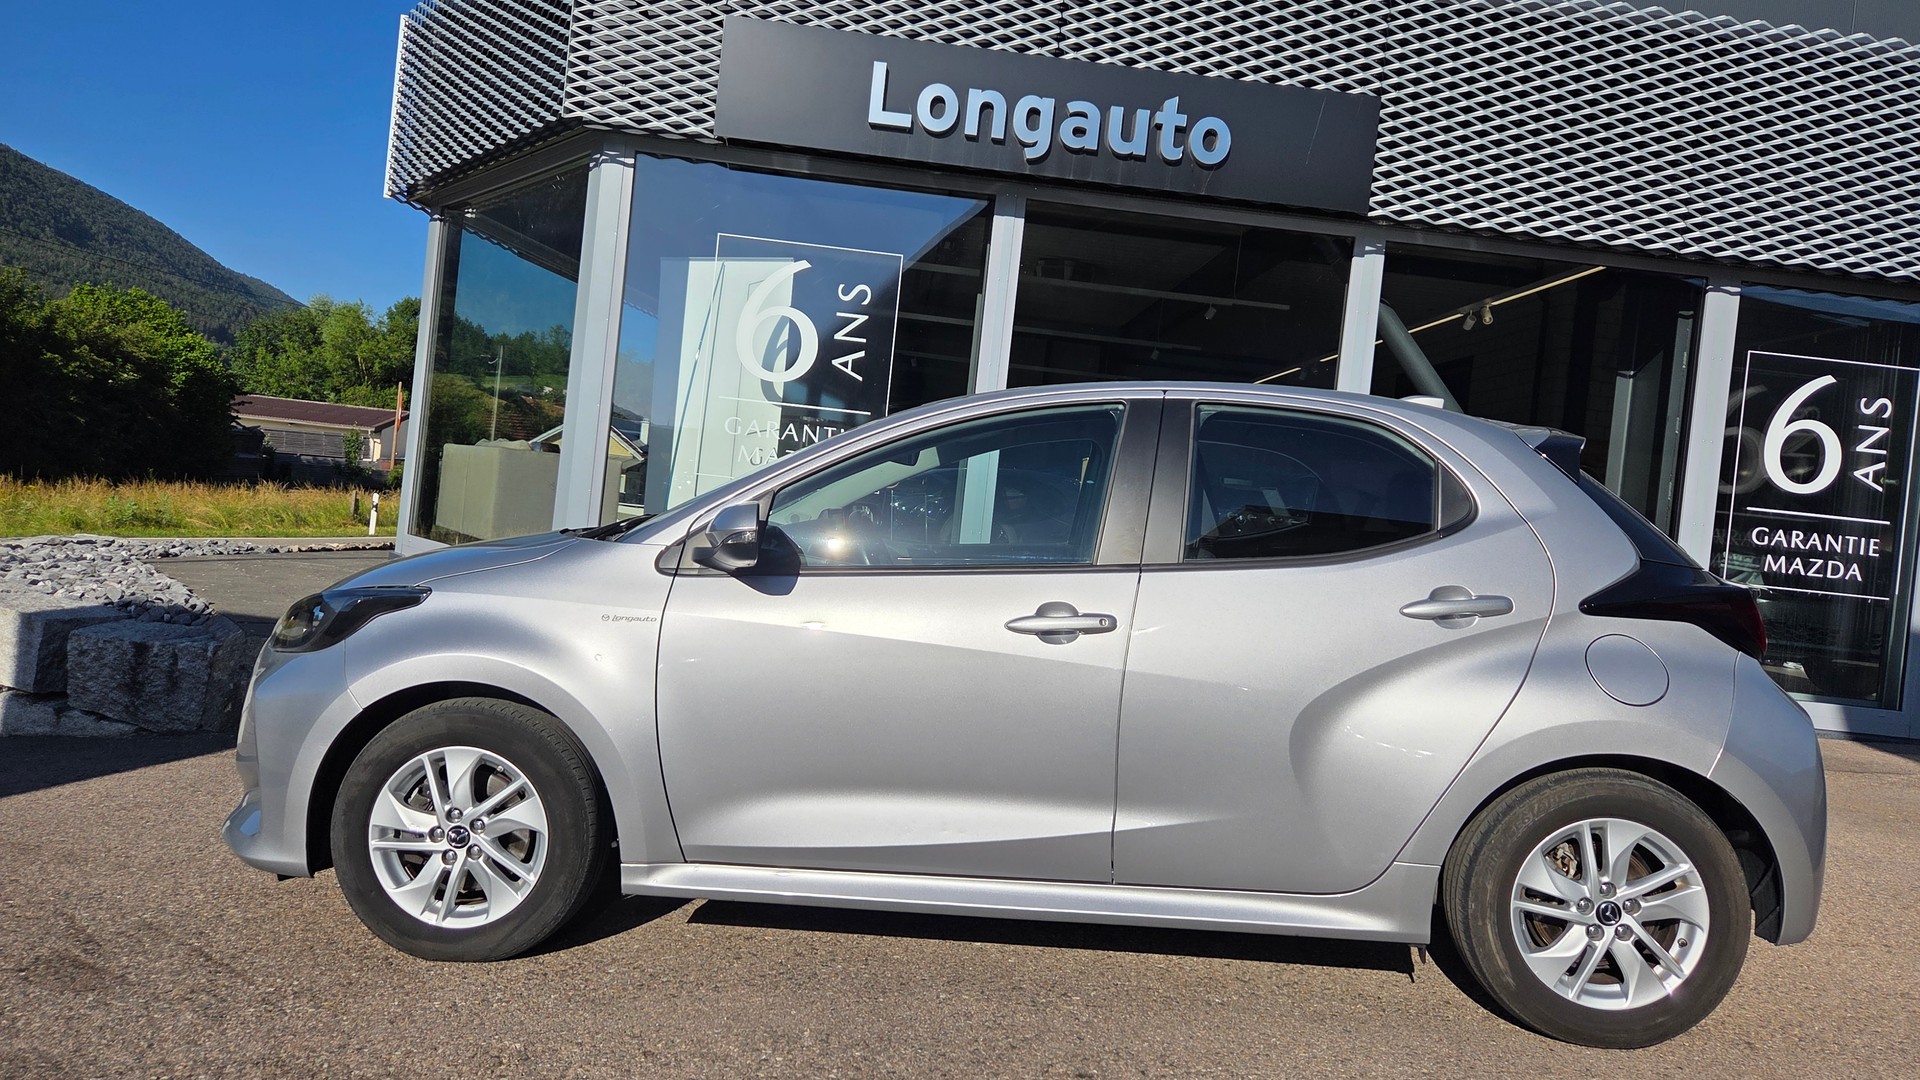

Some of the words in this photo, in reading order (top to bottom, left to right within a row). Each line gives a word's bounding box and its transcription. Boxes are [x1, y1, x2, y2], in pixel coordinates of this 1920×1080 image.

[867, 60, 1232, 167] Longauto
[736, 260, 819, 383] 6
[832, 283, 872, 382] ANS
[724, 416, 846, 443] GARANT
[1763, 374, 1842, 495] 6
[1851, 396, 1893, 493] ANS
[1751, 526, 1880, 557] GARANTIE
[1763, 554, 1863, 582] MAZDA
